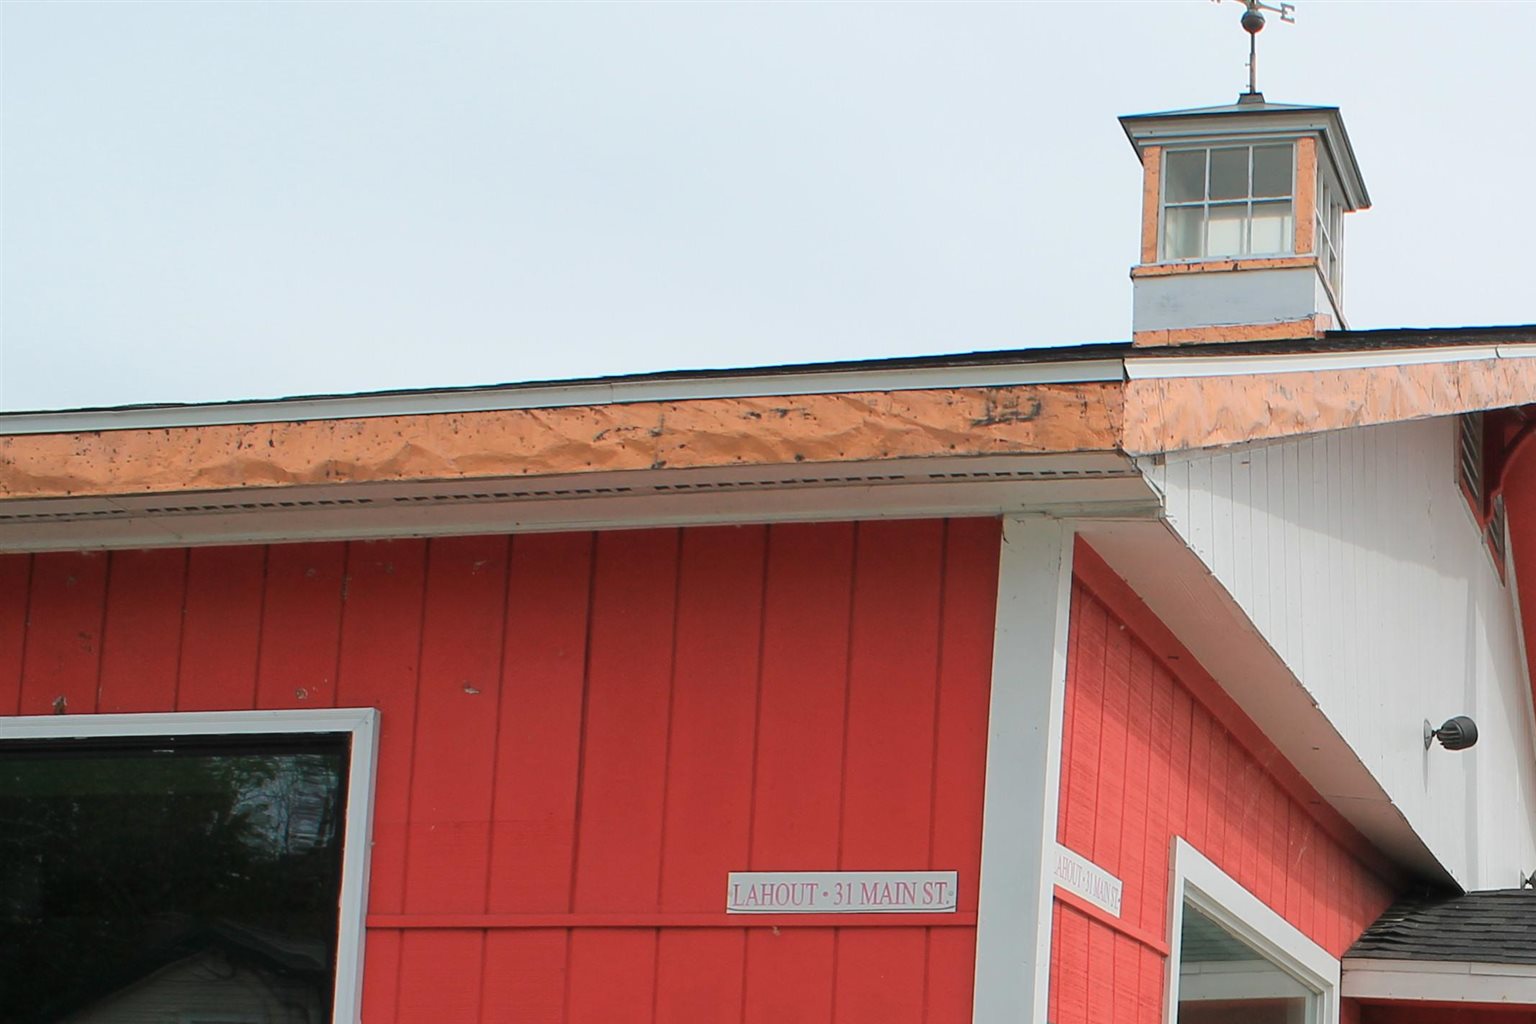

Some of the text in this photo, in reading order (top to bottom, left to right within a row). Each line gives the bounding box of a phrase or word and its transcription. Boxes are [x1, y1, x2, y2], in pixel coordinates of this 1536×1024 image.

[1054, 855, 1082, 888] AHOUT
[732, 881, 950, 906] LAHOUT 31 MAIN ST.
